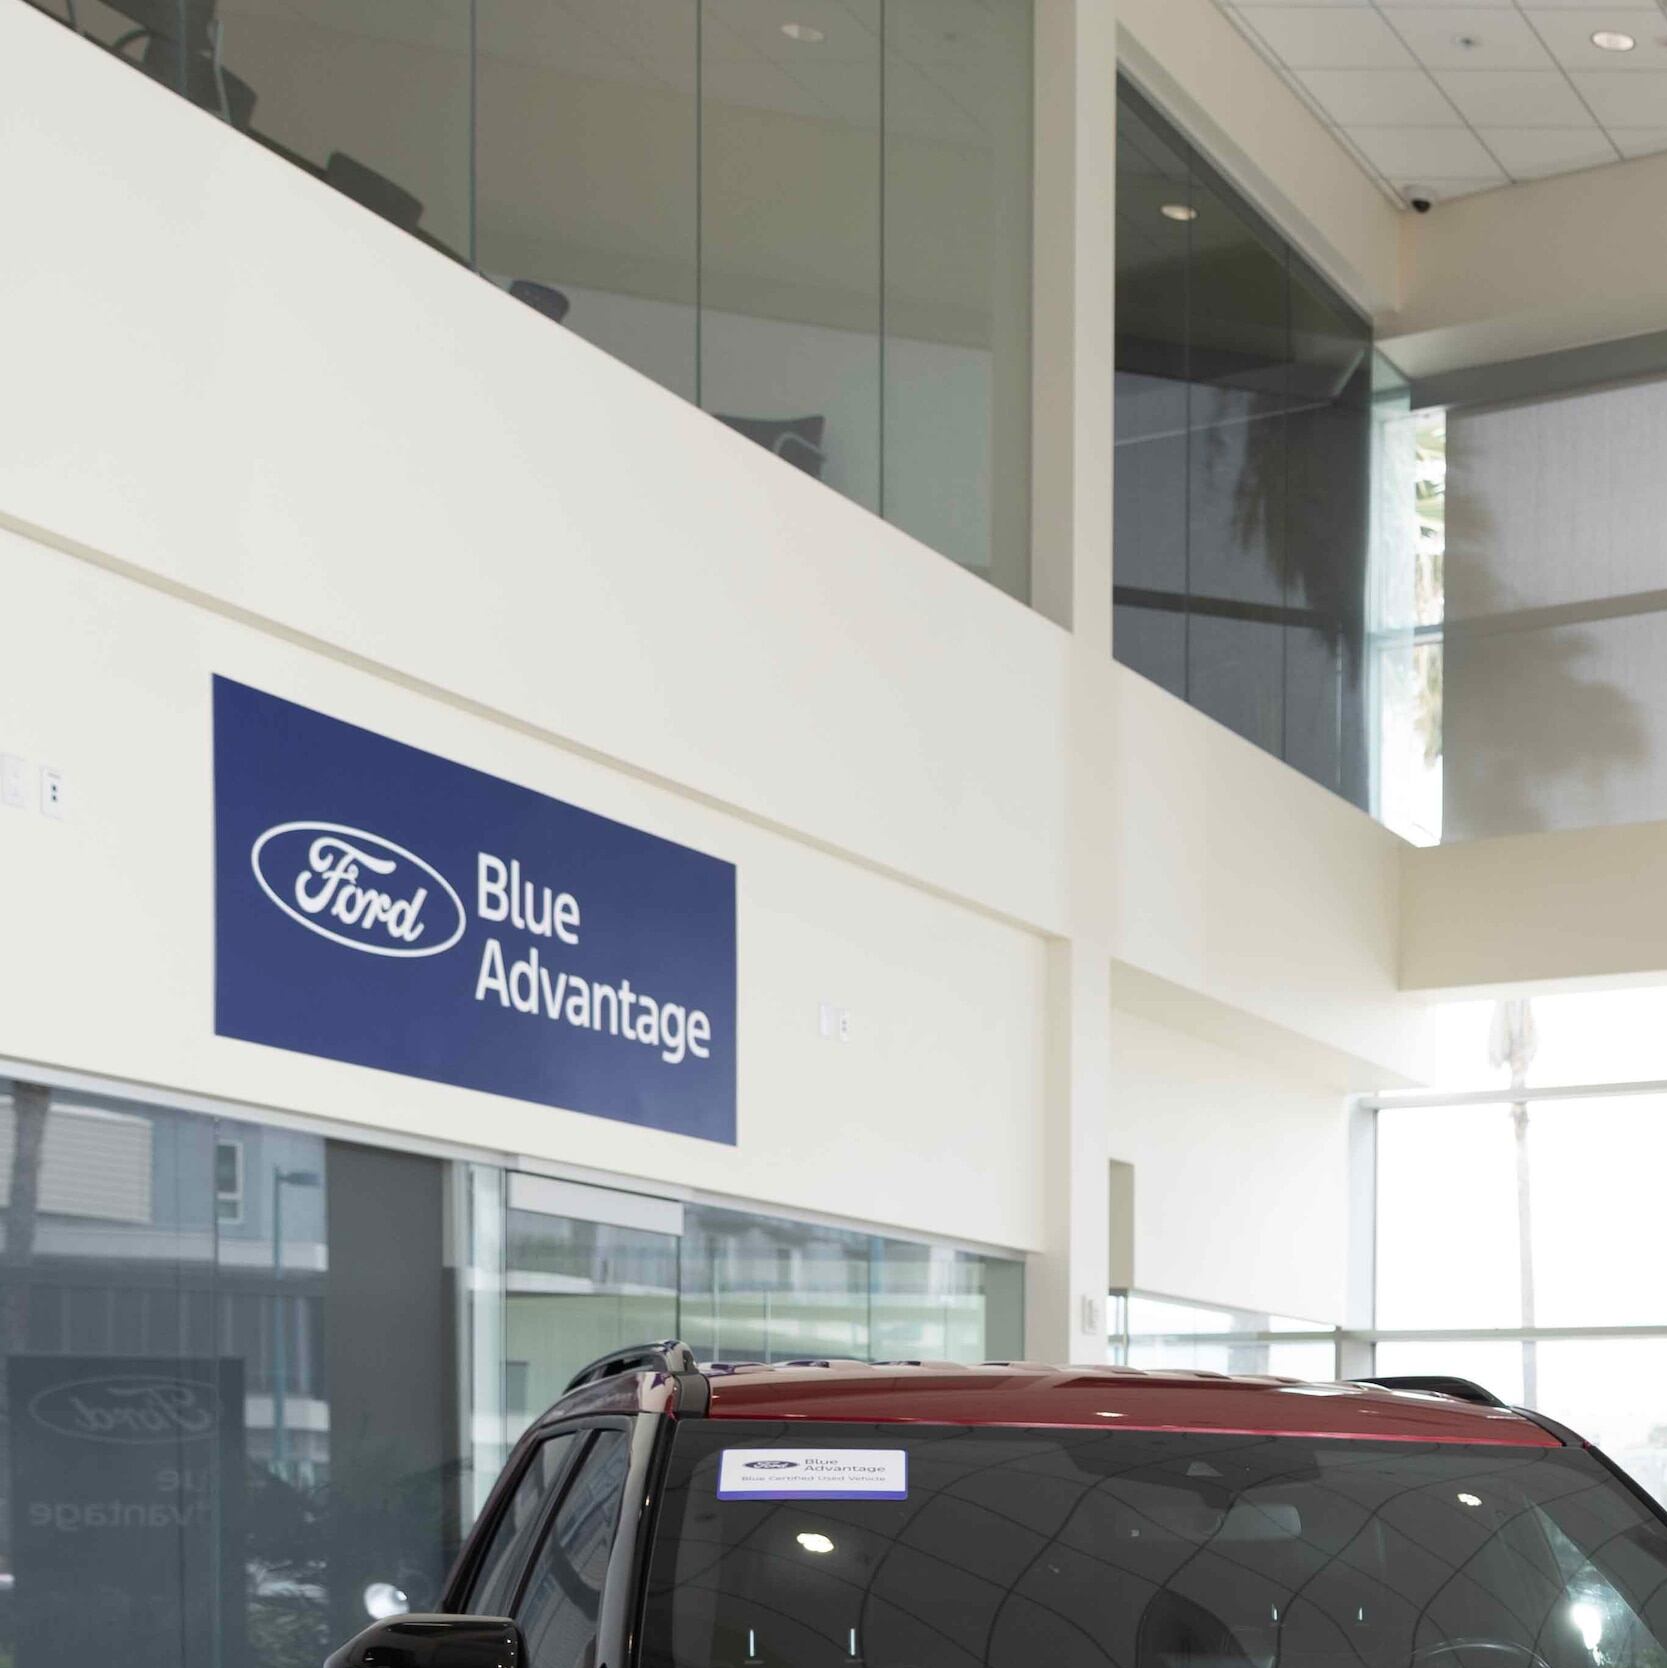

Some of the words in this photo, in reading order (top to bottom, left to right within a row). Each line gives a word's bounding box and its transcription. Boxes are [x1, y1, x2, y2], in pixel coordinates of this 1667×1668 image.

[295, 837, 427, 942] Ford
[478, 851, 581, 945] Blue
[475, 938, 711, 1064] Advantage
[804, 1465, 886, 1473] Advantage
